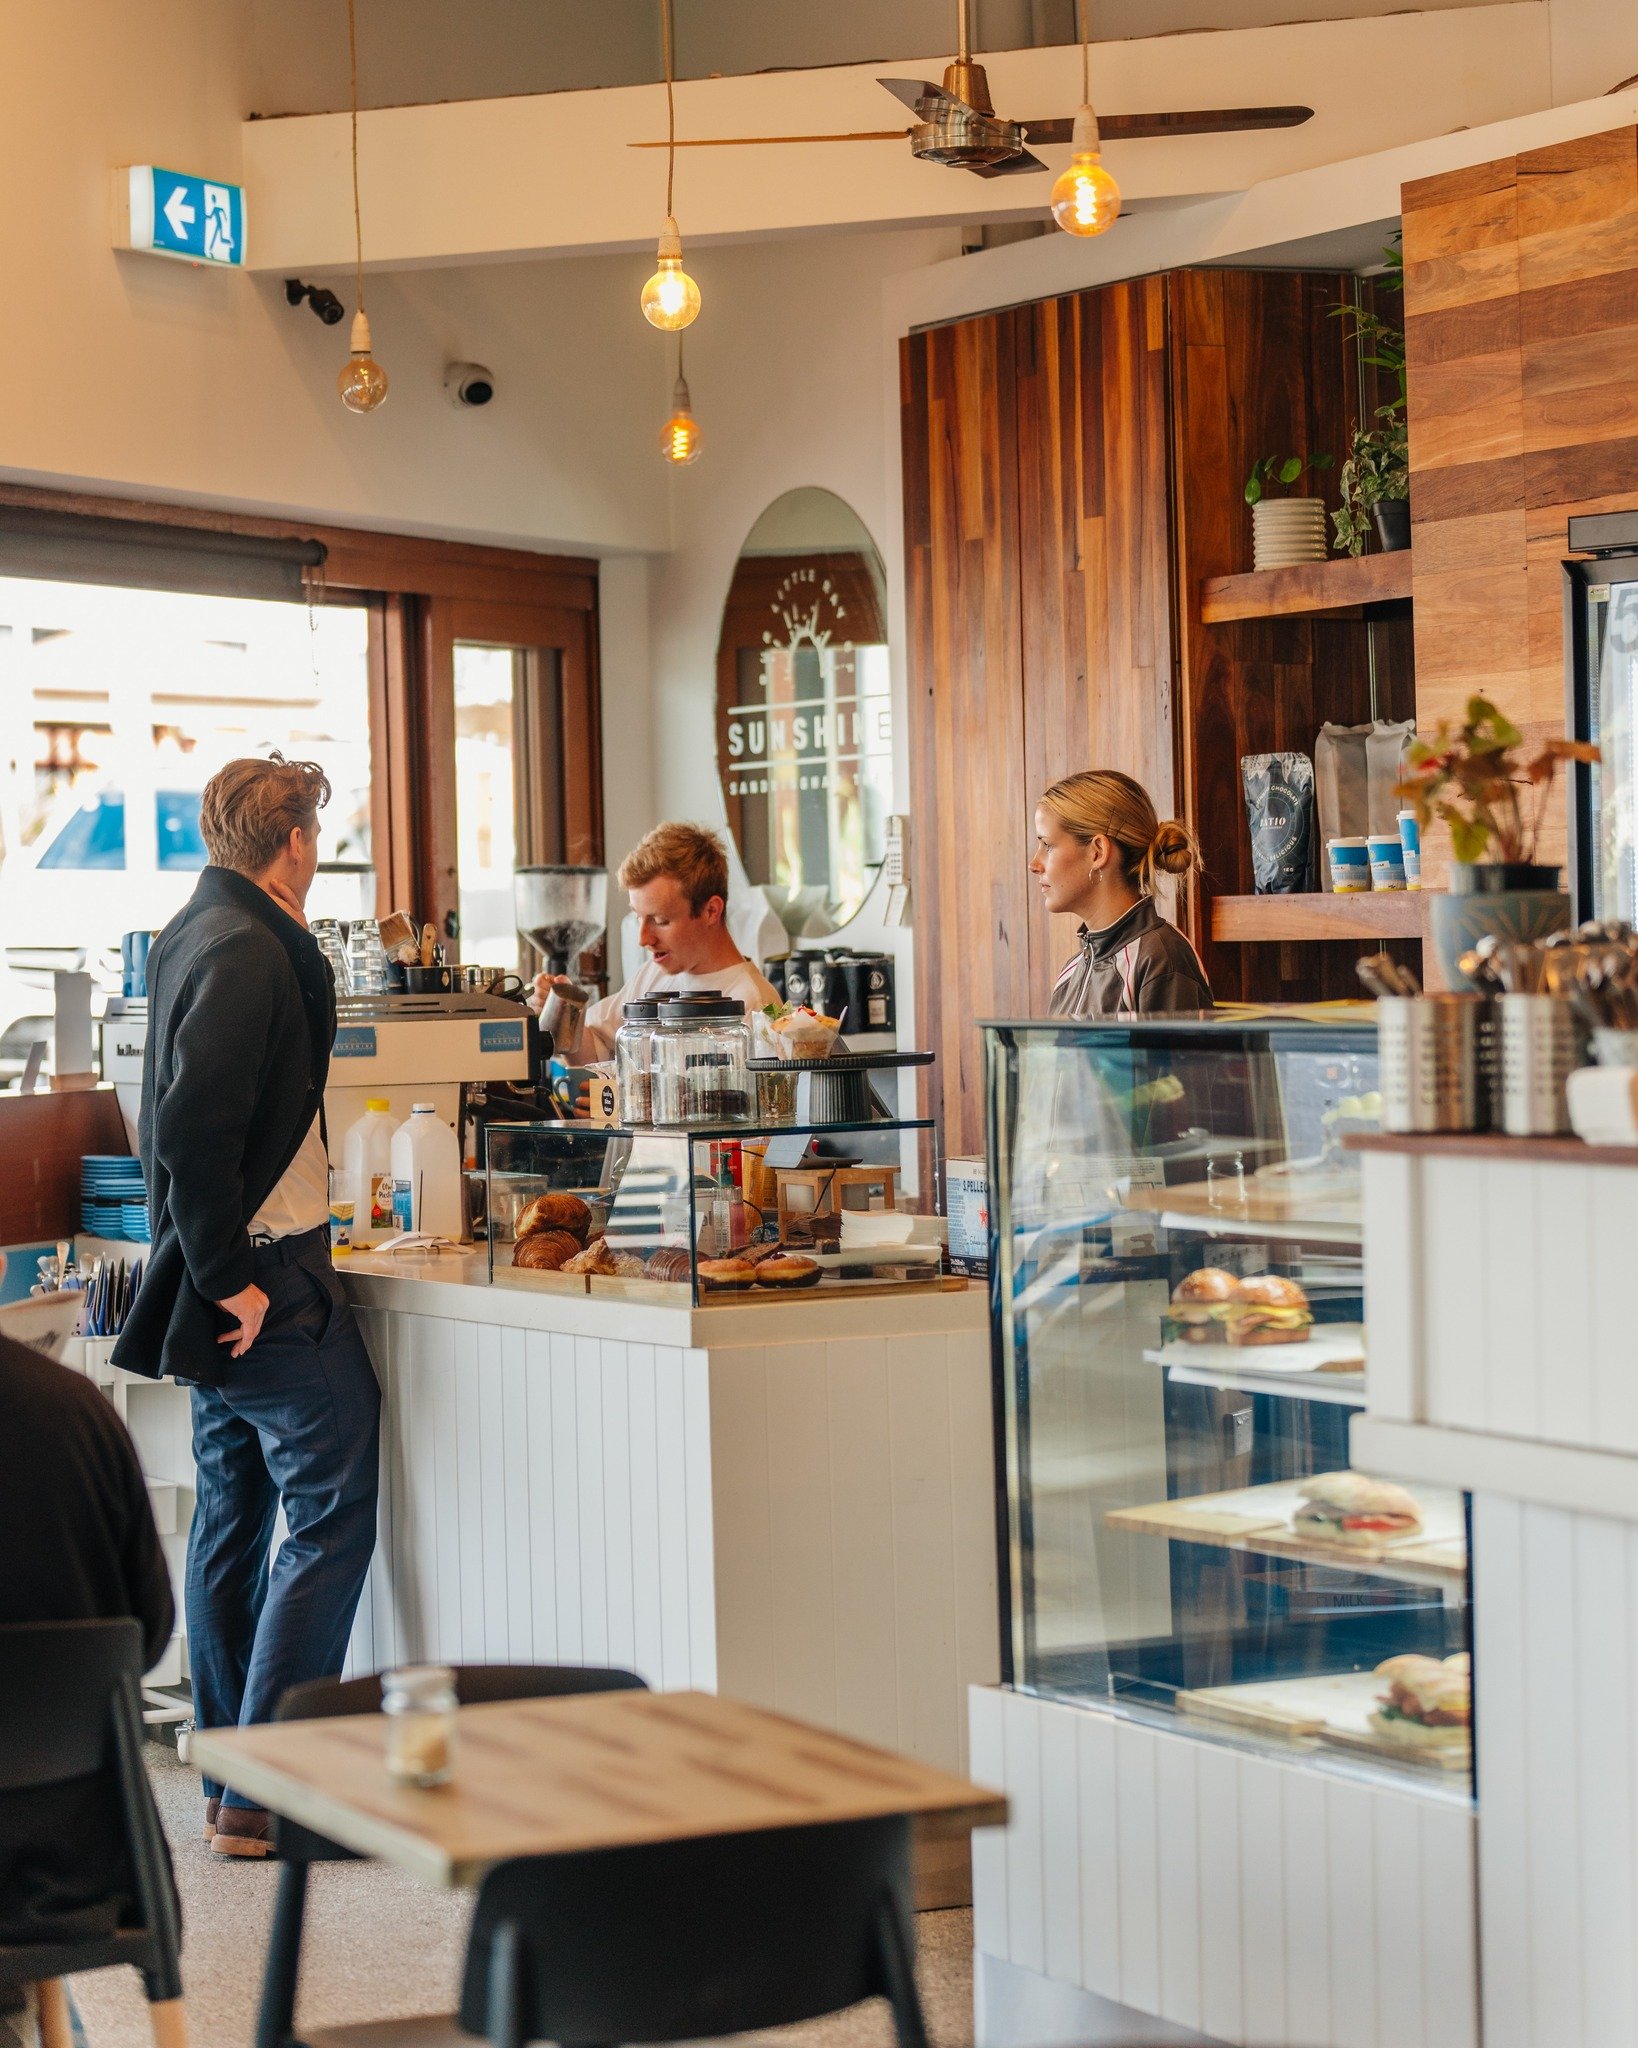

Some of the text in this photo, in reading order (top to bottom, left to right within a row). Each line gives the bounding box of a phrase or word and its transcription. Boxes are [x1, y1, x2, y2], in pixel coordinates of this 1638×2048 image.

[728, 711, 892, 756] SUNSHINE
[1270, 785, 1299, 806] CHOCOLATE
[1333, 1594, 1364, 1607] MILK
